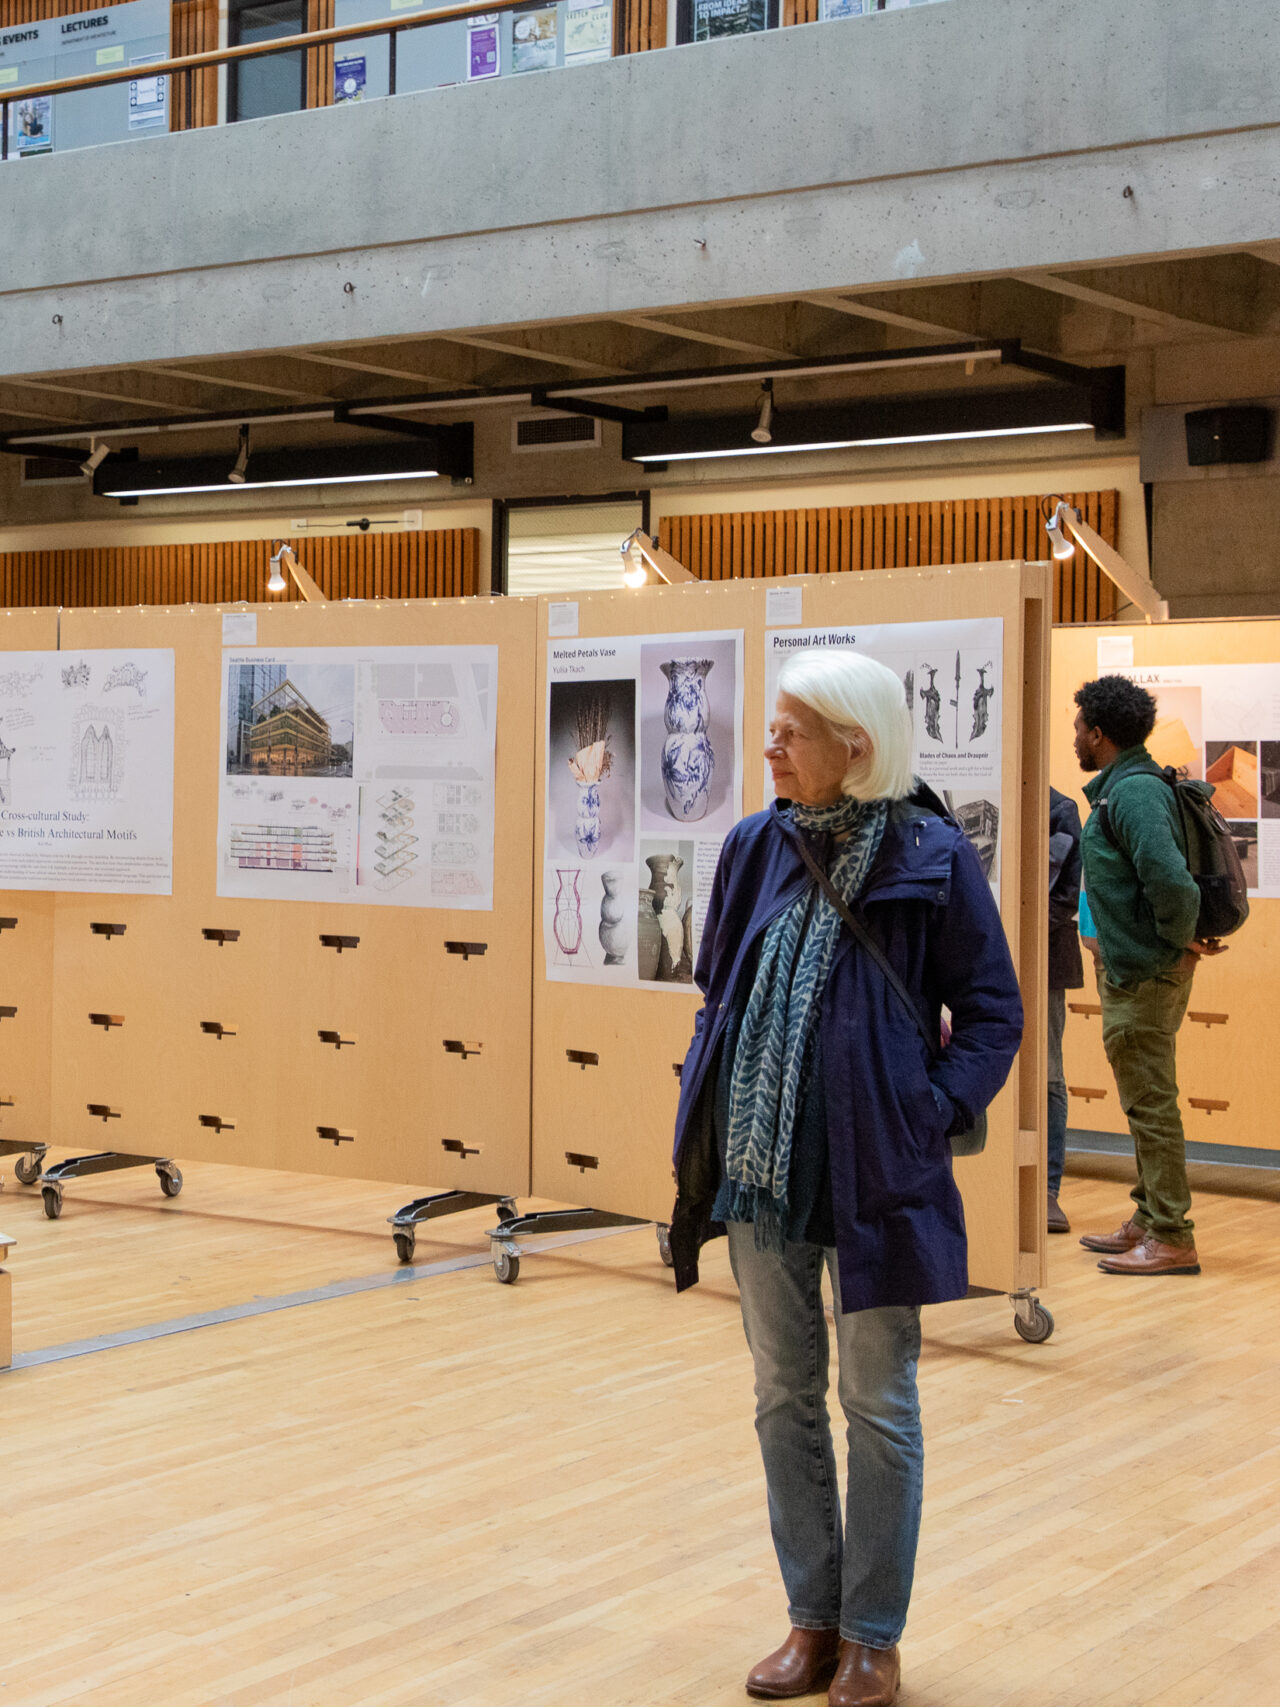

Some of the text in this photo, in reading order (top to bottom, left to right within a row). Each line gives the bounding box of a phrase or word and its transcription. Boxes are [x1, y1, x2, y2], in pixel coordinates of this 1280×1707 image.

[699, 6, 741, 19] TO IMPACT
[61, 15, 108, 34] LECTURES
[3, 30, 39, 45] EVENTS
[773, 633, 856, 648] Personal Art Works
[553, 648, 617, 660] Melted Petals Vase
[1, 810, 90, 823] Cross-cultural Study:
[6, 829, 15, 838] vs
[17, 828, 46, 839] British
[49, 829, 104, 840] Architectural
[106, 829, 138, 840] Motifs
